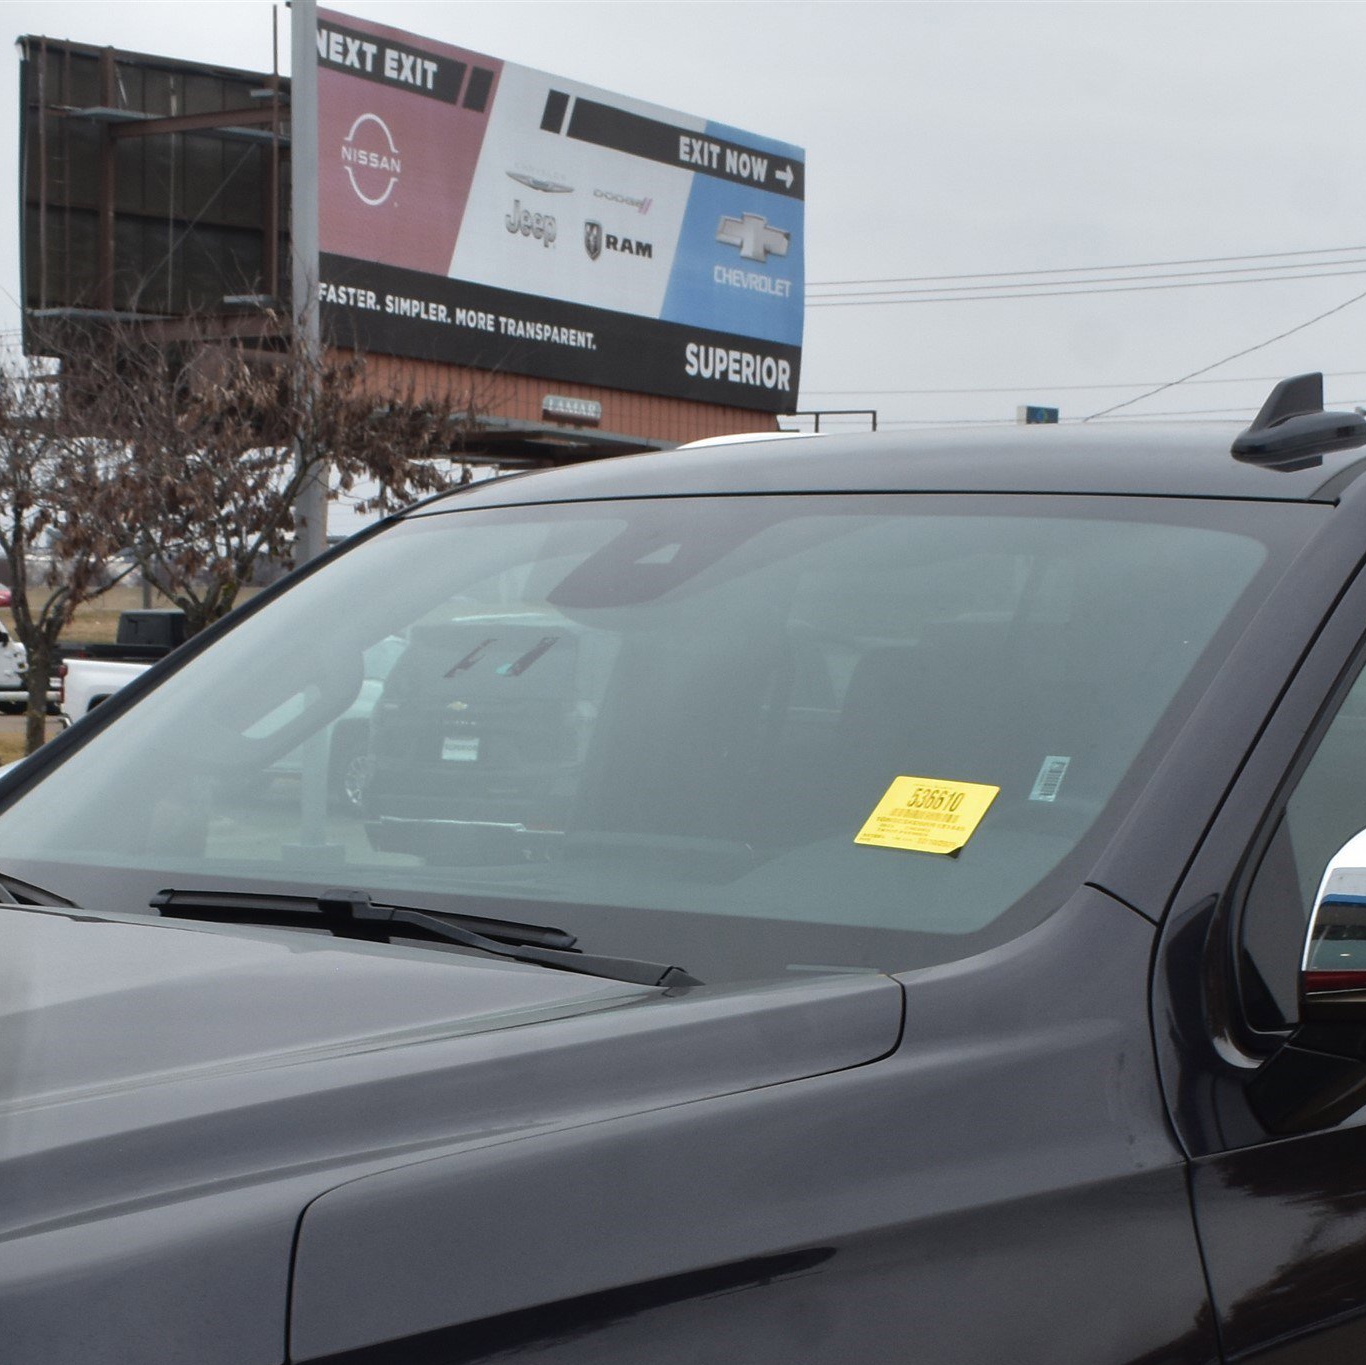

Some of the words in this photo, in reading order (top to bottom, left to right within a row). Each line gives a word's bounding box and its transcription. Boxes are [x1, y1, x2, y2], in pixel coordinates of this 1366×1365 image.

[316, 27, 377, 73] NEXT
[384, 48, 438, 90] EXIT
[341, 145, 402, 173] NISSAN
[679, 135, 721, 170] EXIT
[725, 148, 768, 183] NOW
[505, 199, 557, 248] Jeep
[605, 233, 653, 259] RAM
[713, 265, 793, 298] CHEVROLET
[319, 282, 381, 312] FASTER.
[385, 294, 451, 324] SIMPLER.
[455, 307, 495, 333] MORE
[499, 315, 597, 351] TRANSPARENT.
[684, 342, 791, 392] SUPERIOR
[906, 787, 967, 813] 536610
